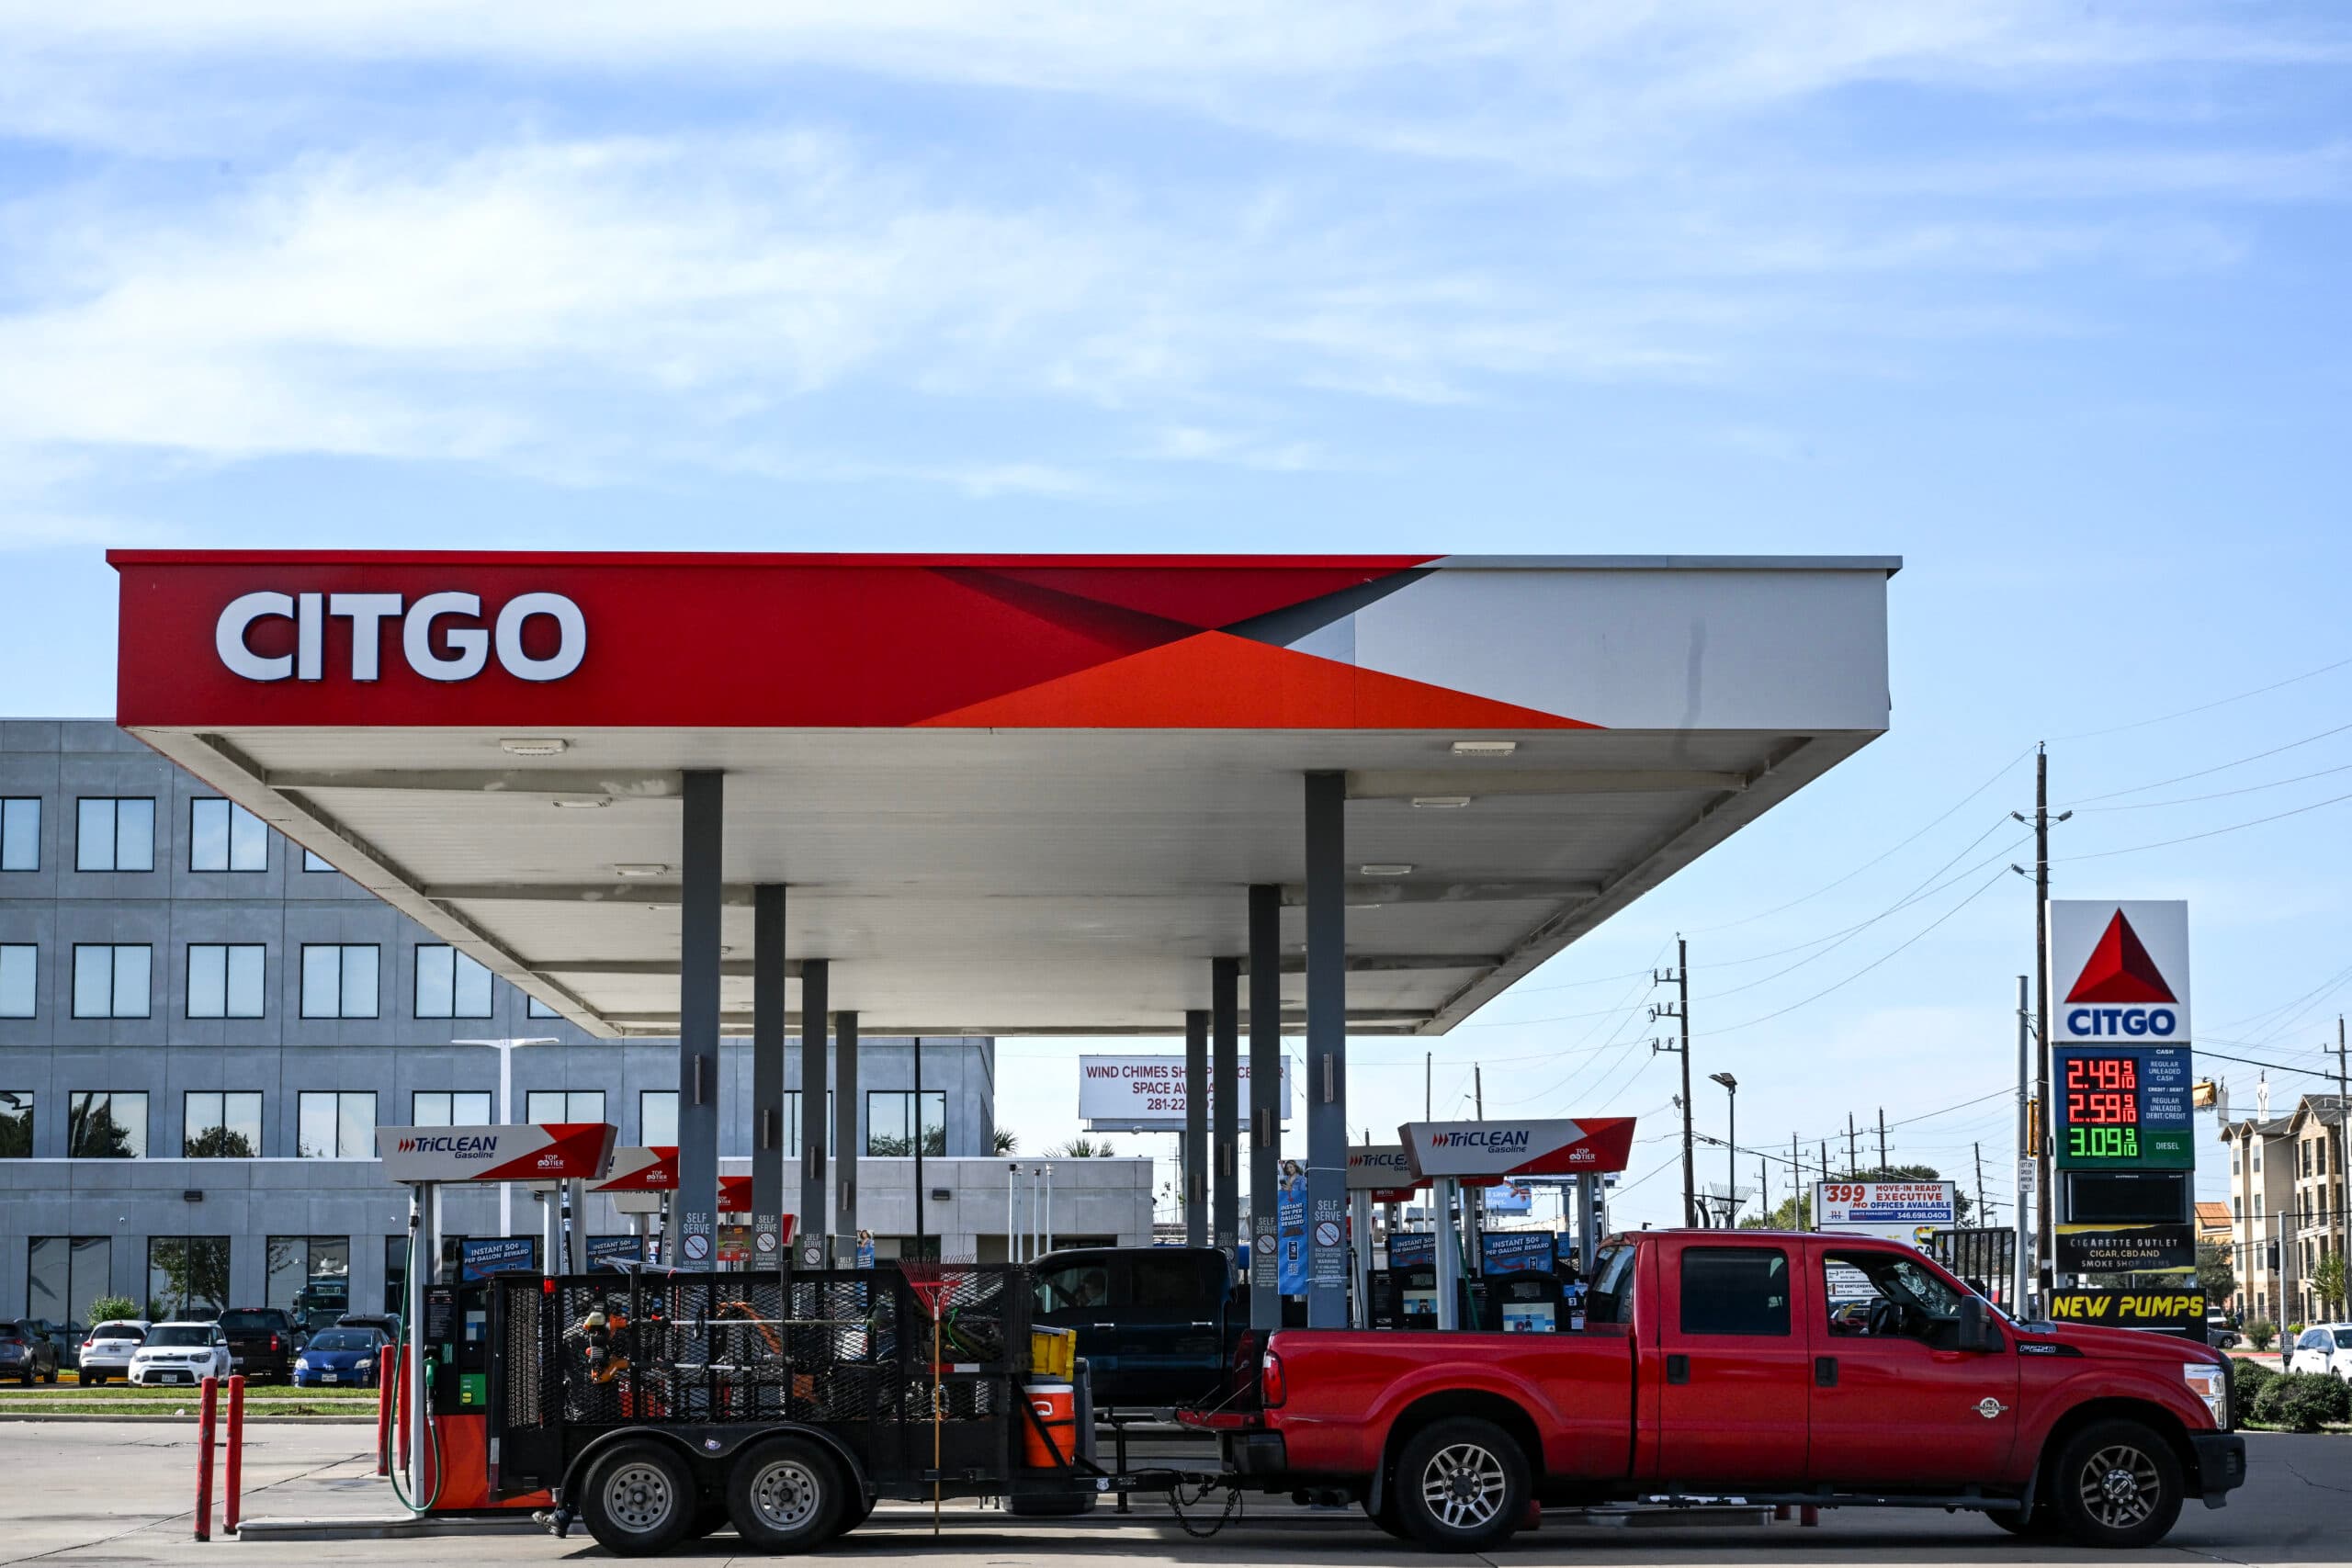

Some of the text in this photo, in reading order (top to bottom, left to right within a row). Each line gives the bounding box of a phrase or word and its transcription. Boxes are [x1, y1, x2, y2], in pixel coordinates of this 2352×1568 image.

[215, 591, 587, 682] CITGO
[2067, 1009, 2177, 1036] CITGO
[1086, 1066, 1119, 1078] WIND
[1122, 1066, 1169, 1078] CHIMES
[1132, 1082, 1170, 1094] SPACE
[1448, 1131, 1529, 1146] TriCLEAN
[2070, 1128, 2121, 1156] 3.09
[415, 1136, 498, 1152] TriCLEAN
[1487, 1145, 1527, 1154] Gasoline
[455, 1151, 494, 1159] Gasoline
[1824, 1185, 1866, 1202] $399
[1281, 1202, 1303, 1211] INSTANT
[1317, 1201, 1339, 1210] SELF
[686, 1213, 707, 1223] SELF
[1259, 1217, 1274, 1225] SELF
[1315, 1212, 1341, 1222] SERVE
[684, 1224, 710, 1234] SERVE
[755, 1224, 777, 1232] SERVE
[1257, 1225, 1277, 1234] SERVE
[1397, 1239, 1422, 1247] INSTANT
[1492, 1238, 1524, 1248] INSTANT
[2070, 1238, 2177, 1247] CIGARETTE OUTLET
[471, 1245, 503, 1256] INSTANT
[2120, 1249, 2139, 1258] CBD
[2140, 1249, 2160, 1258] AND
[464, 1248, 529, 1264] PER GALLON REWARD
[2081, 1259, 2113, 1268] SMOKE
[2117, 1259, 2140, 1268] SHOP
[2052, 1295, 2205, 1317] NEW PUMPS
